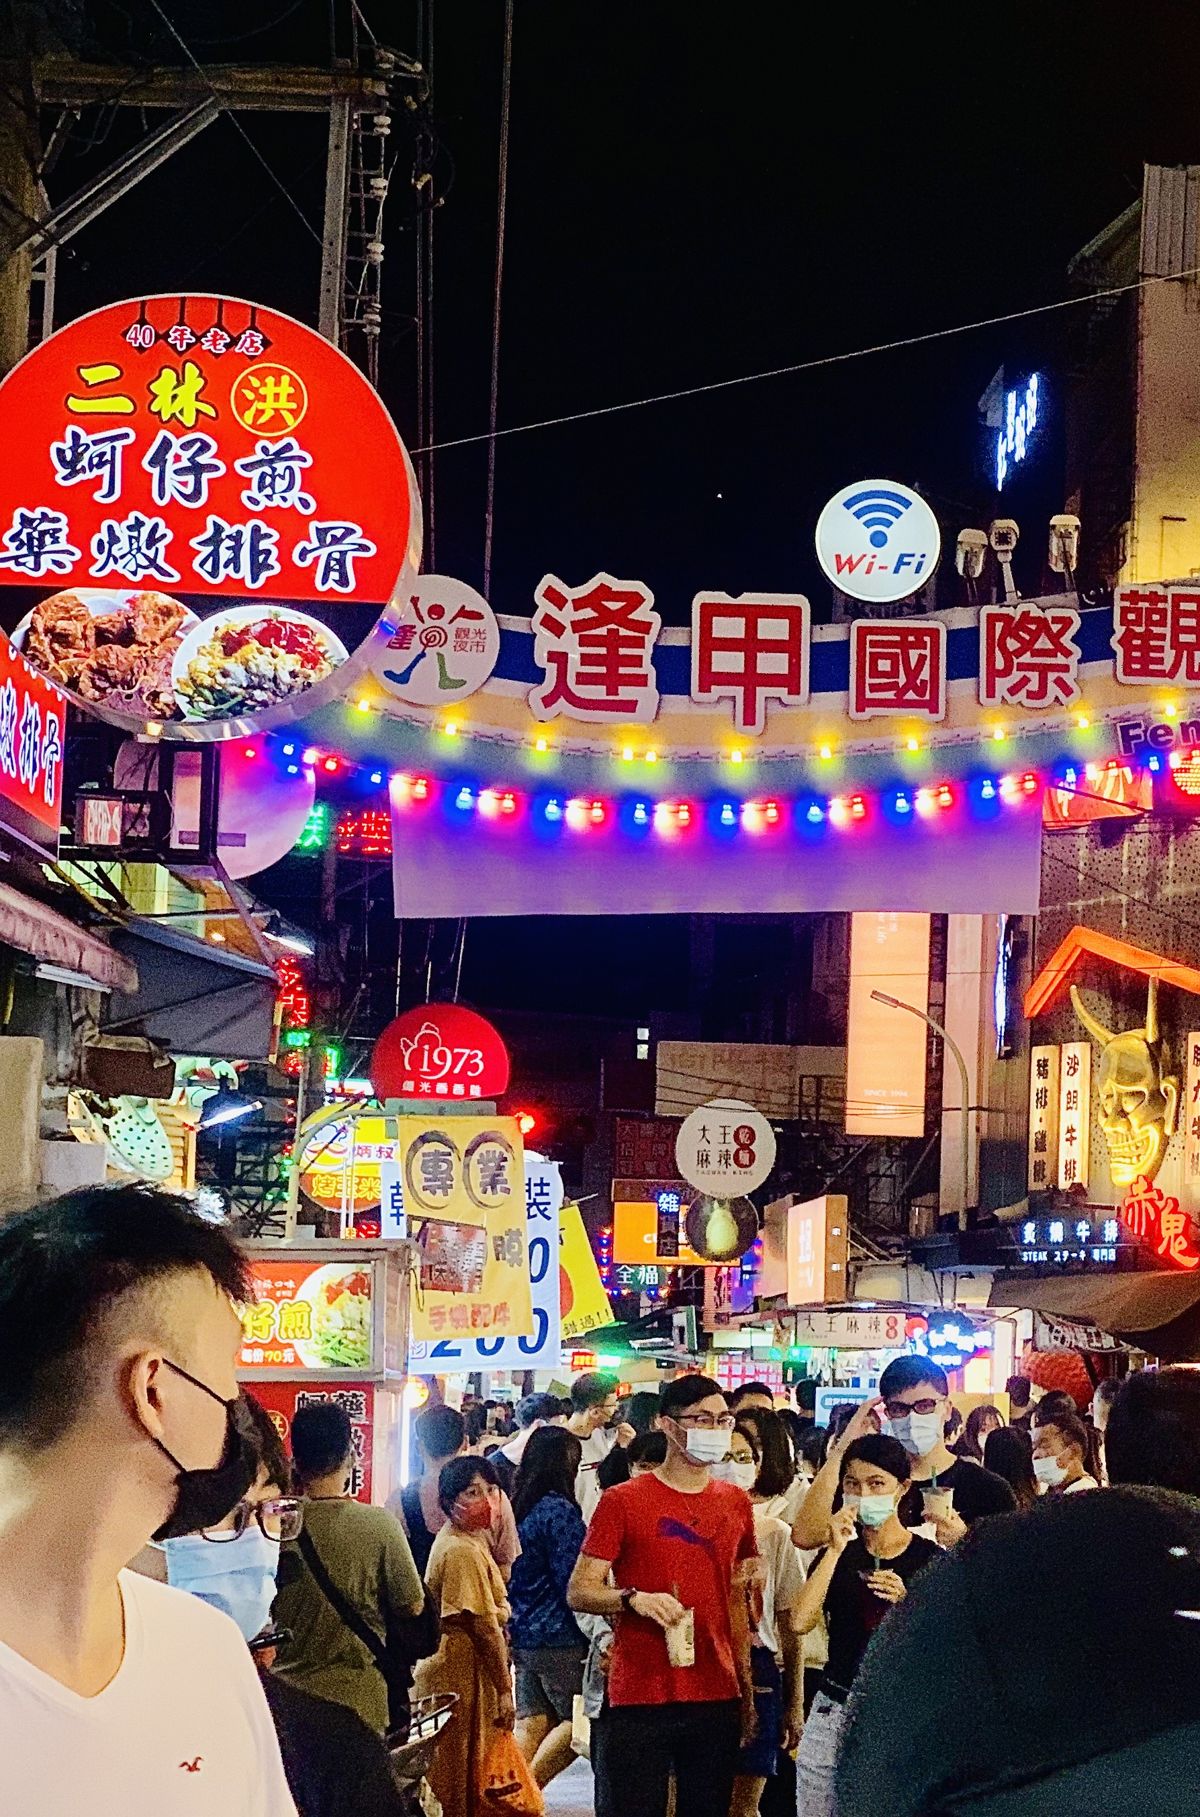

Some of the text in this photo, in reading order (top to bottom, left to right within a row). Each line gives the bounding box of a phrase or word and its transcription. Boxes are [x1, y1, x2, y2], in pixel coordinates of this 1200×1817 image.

[126, 323, 266, 356] 40年老店
[65, 363, 299, 428] 二林 洪
[50, 424, 317, 516] 蚵仔煎
[0, 505, 378, 592] 藥燉排骨
[833, 550, 928, 578] Wi-Fi
[419, 1044, 485, 1080] 1973
[698, 1124, 731, 1145] 大王
[1064, 1053, 1080, 1182] 沙朗牛排
[419, 1149, 512, 1197] 專業
[697, 1149, 732, 1169] 麻辣
[1021, 1251, 1048, 1262] STEAK
[1053, 1249, 1087, 1262] ステーキ
